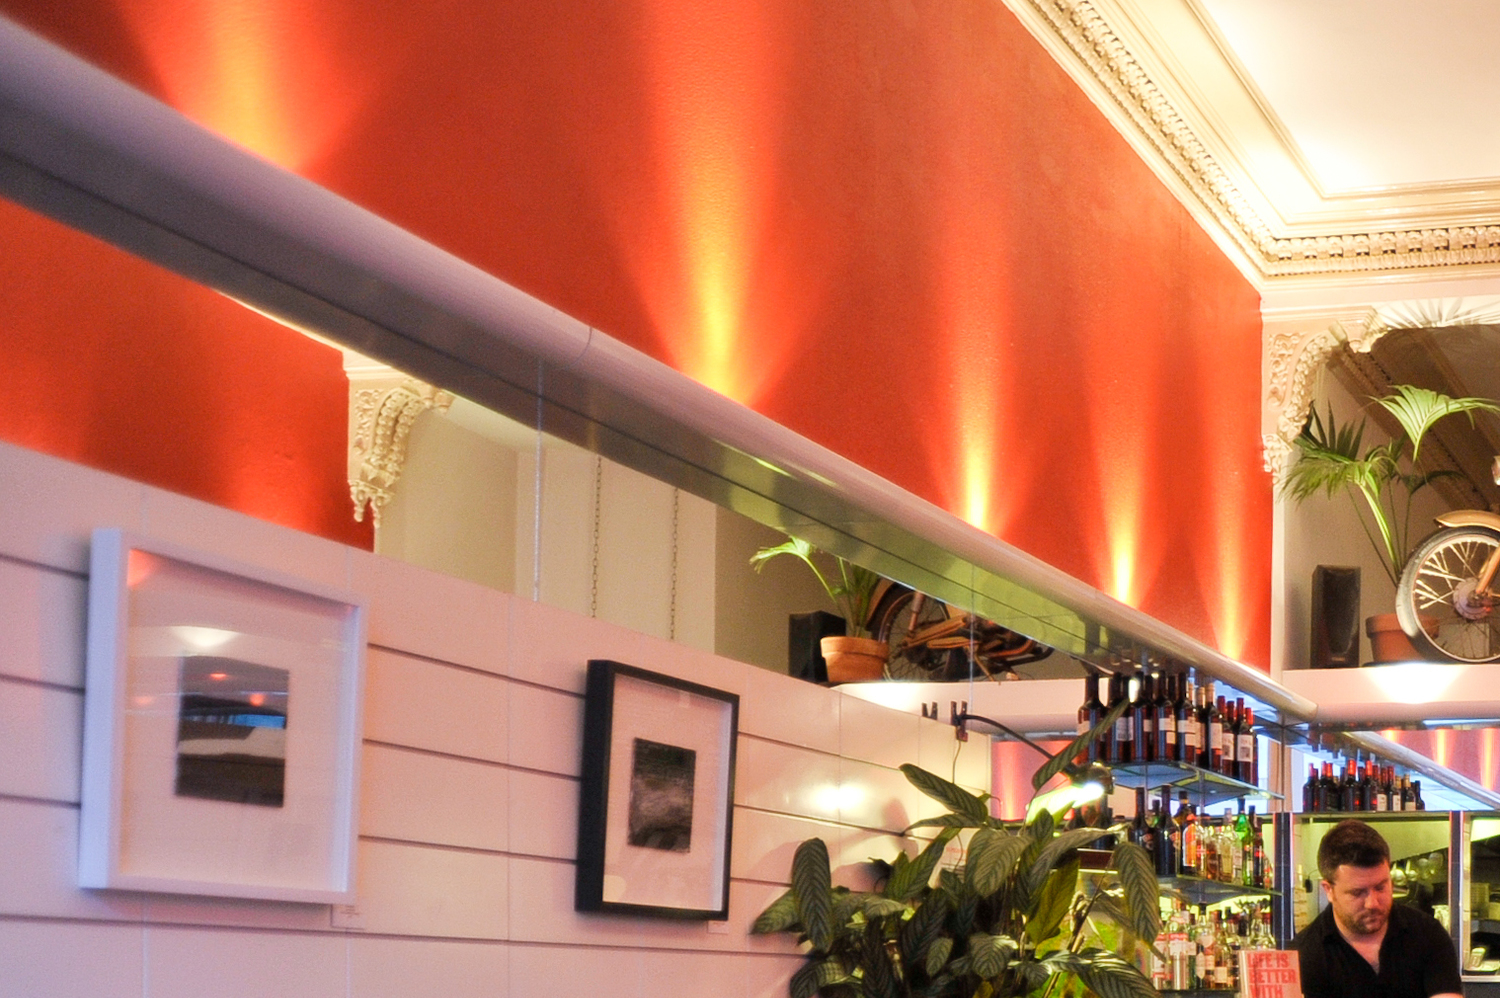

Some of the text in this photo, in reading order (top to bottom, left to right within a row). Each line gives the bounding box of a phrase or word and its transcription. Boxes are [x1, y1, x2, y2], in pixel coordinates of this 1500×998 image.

[1247, 953, 1289, 968] LIFE IS
[1249, 969, 1297, 984] BETTER
[1250, 985, 1284, 998] WITH
